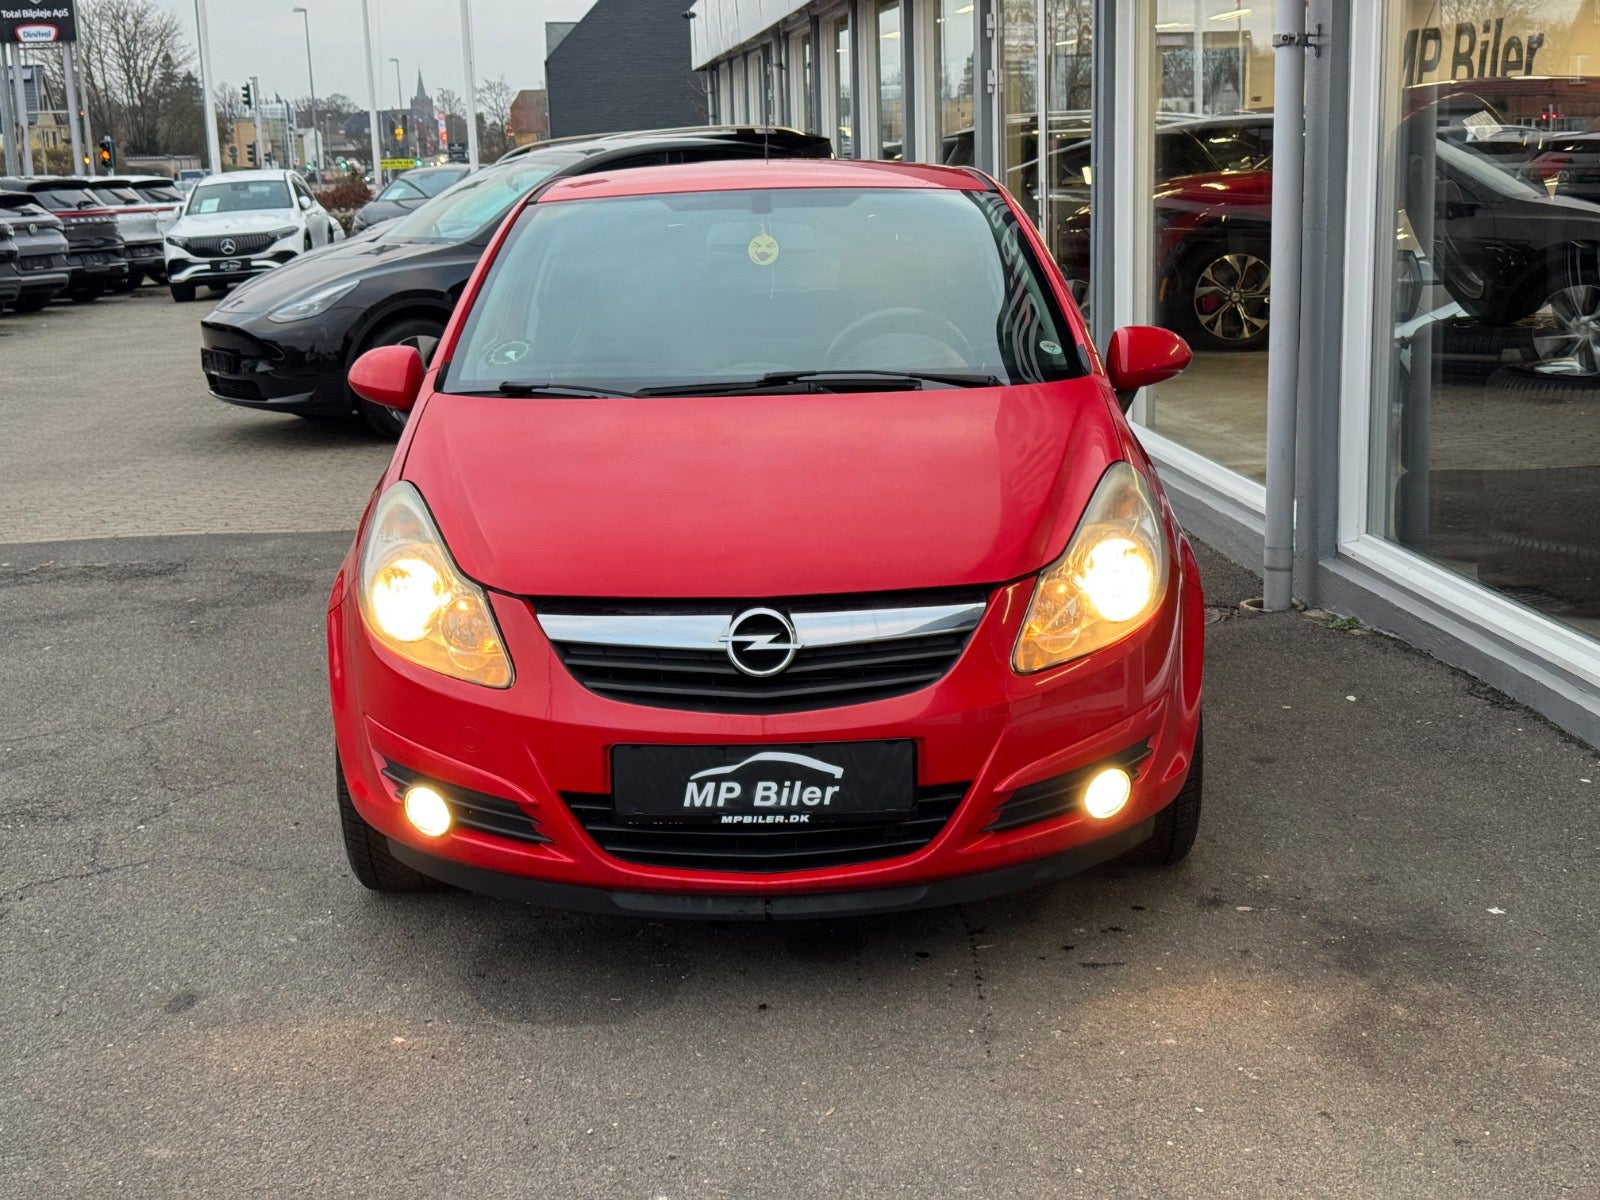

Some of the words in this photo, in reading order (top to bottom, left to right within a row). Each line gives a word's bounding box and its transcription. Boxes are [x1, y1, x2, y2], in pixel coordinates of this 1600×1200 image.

[1, 9, 21, 18] Total
[22, 9, 51, 19] Bilpleje
[53, 8, 69, 18] ApS
[1451, 18, 1545, 80] Biler
[683, 782, 742, 807] MP
[753, 781, 840, 806] Biler
[721, 815, 811, 824] MPBILER.DK
